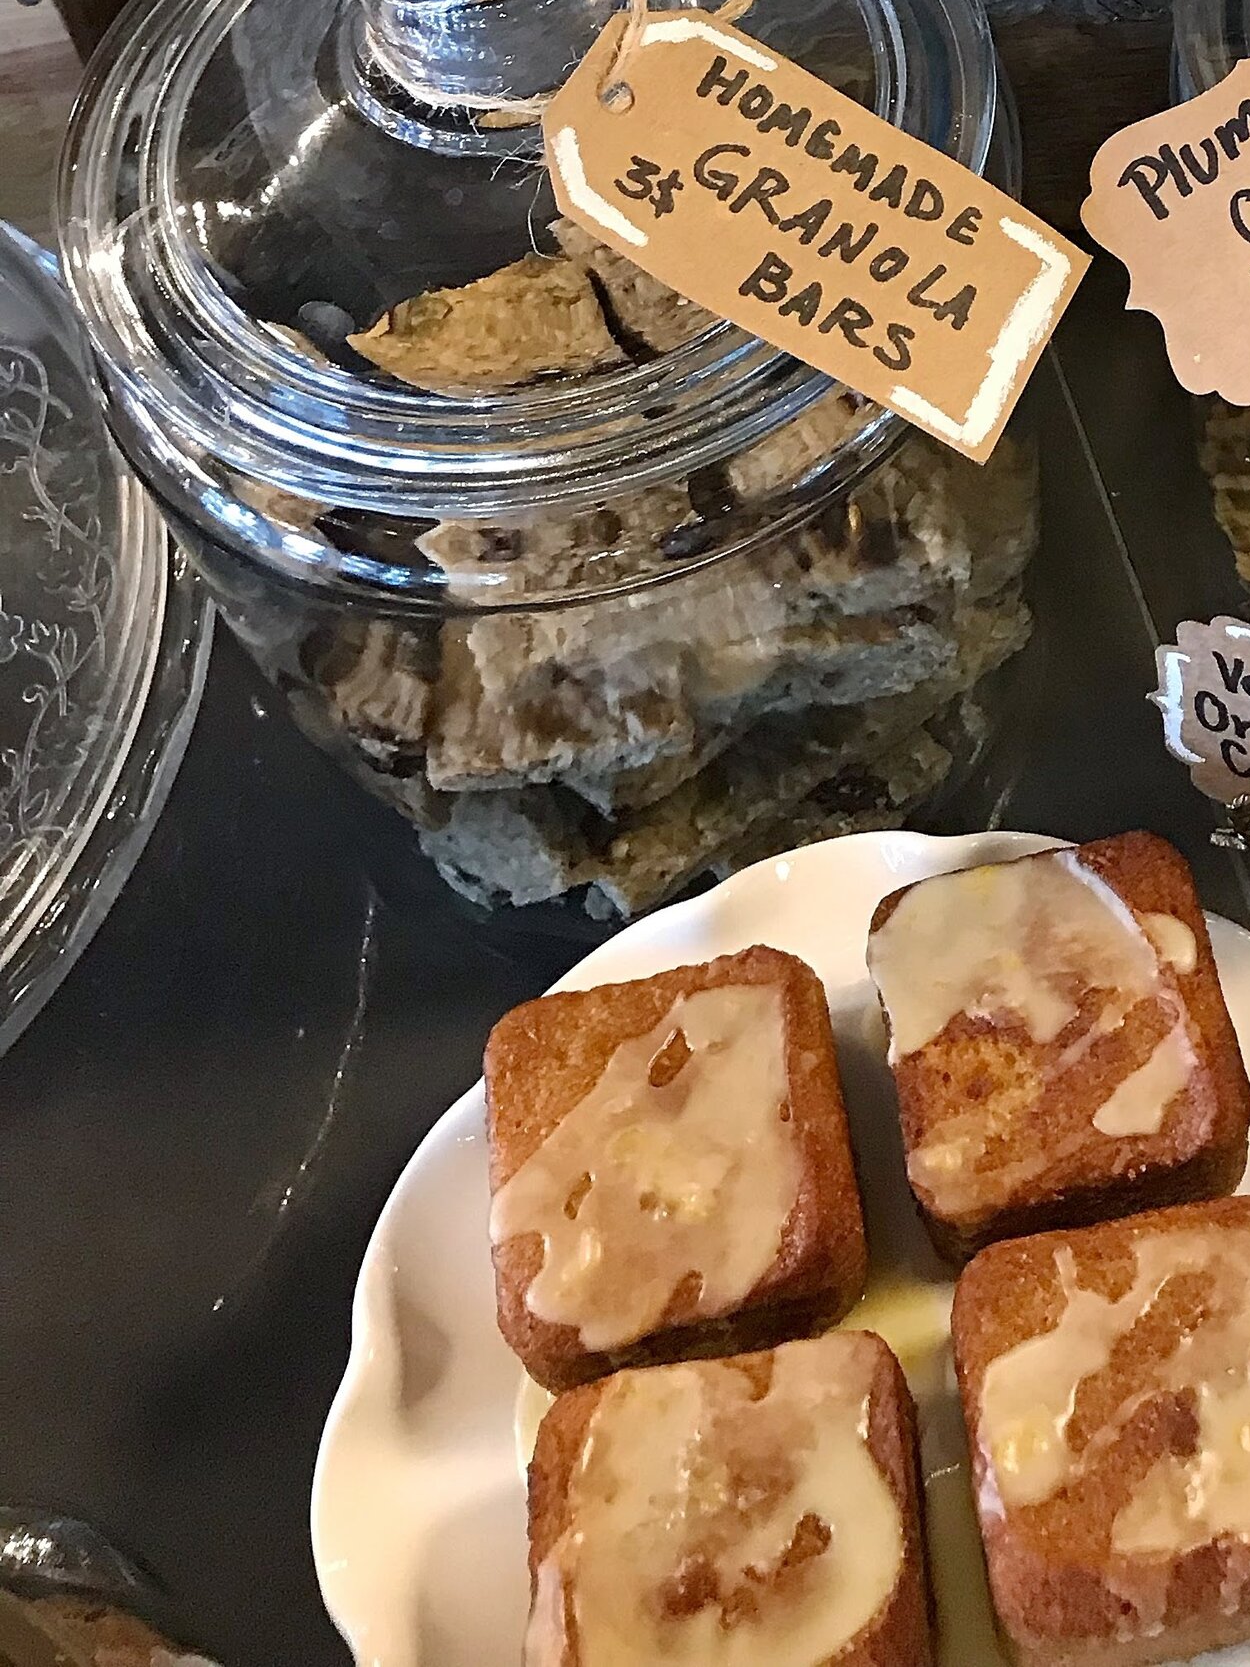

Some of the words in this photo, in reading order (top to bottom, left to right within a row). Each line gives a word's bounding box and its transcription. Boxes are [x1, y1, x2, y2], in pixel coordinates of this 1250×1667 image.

[613, 154, 684, 219] 3$
[696, 55, 982, 246] HOMEMADE
[692, 143, 978, 331] GRANOLA
[738, 251, 917, 372] BARS
